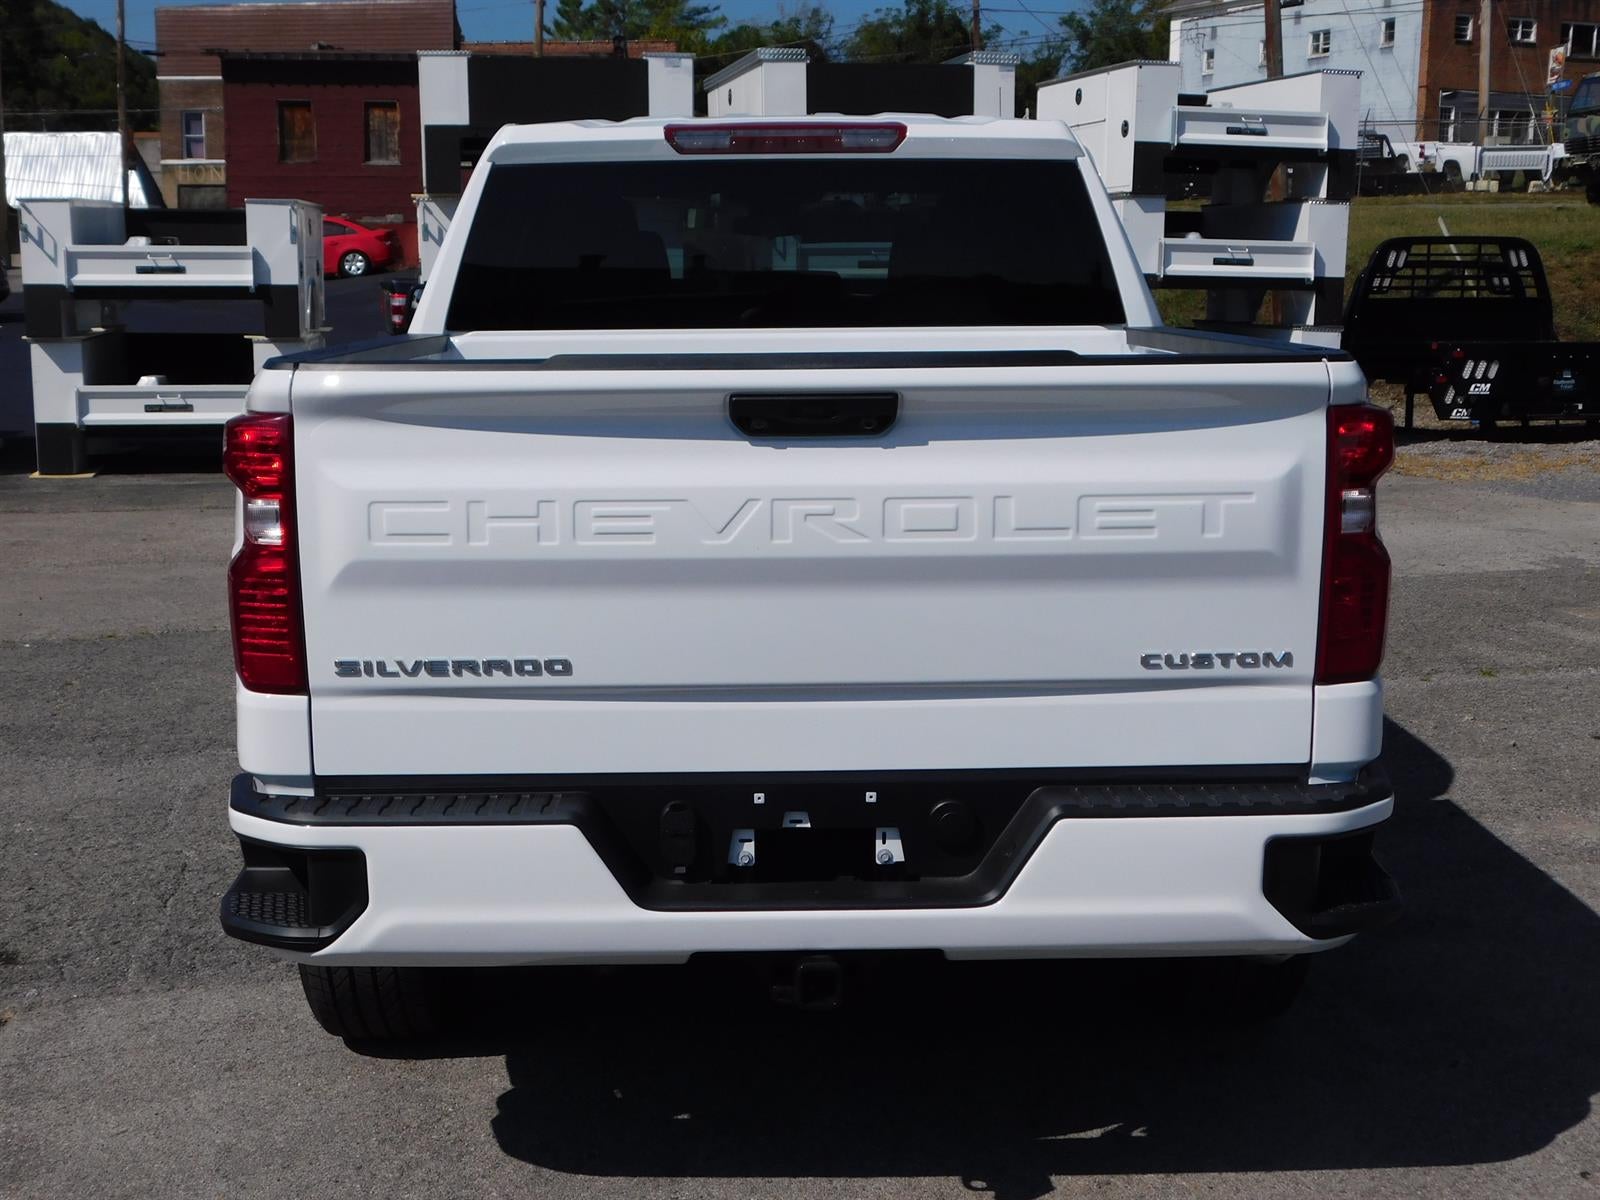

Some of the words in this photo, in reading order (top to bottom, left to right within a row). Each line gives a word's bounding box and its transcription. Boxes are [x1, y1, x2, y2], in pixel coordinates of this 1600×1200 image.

[1469, 383, 1491, 393] CM
[368, 492, 1257, 547] CHEVROLET
[334, 658, 574, 678] SILVERADO
[1140, 651, 1294, 670] CUSTOM
